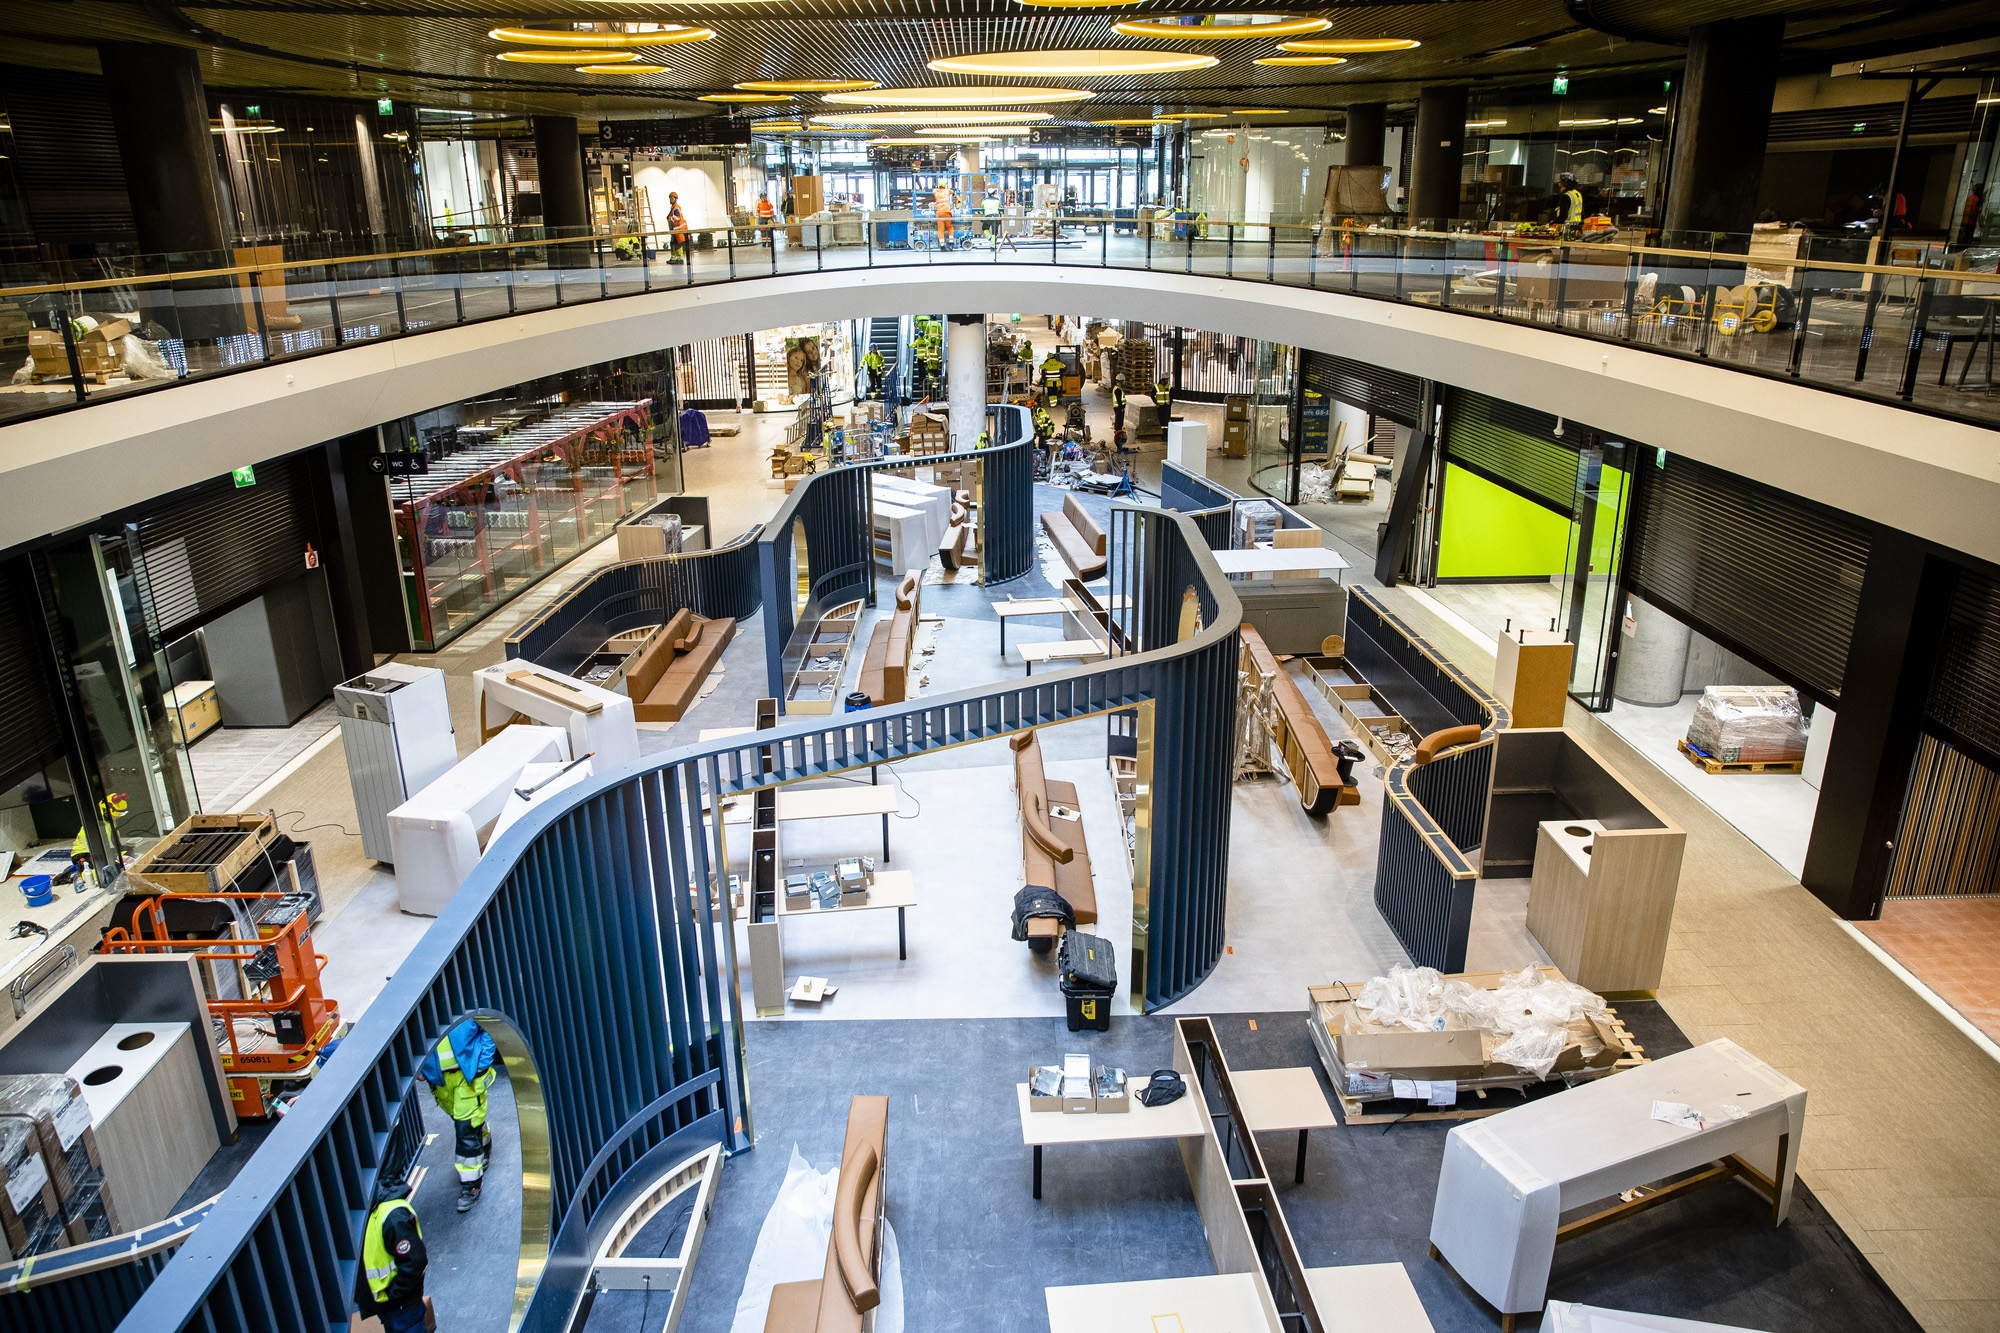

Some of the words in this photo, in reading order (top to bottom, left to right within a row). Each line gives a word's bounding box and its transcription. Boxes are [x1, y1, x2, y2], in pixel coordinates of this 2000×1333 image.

[603, 126, 613, 140] 3
[1032, 131, 1040, 143] 3
[868, 148, 875, 158] 3
[240, 1056, 271, 1064] 650811
